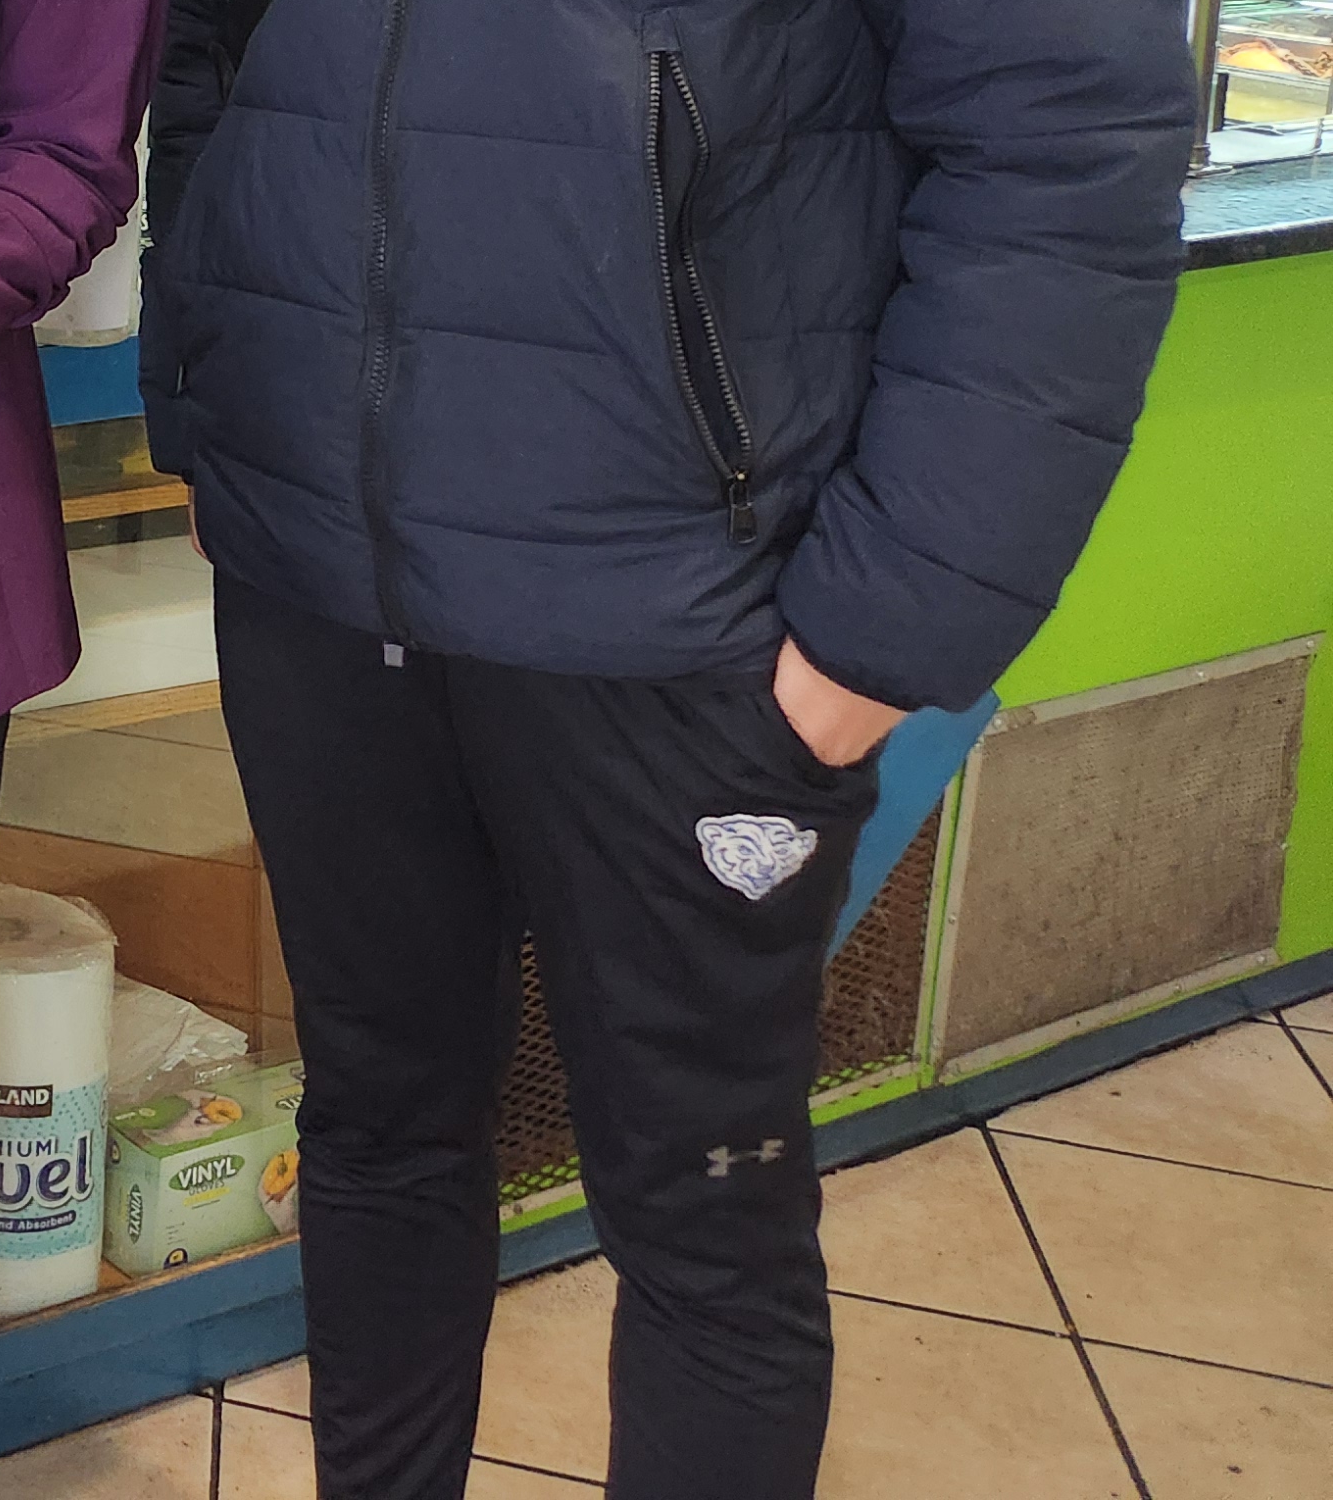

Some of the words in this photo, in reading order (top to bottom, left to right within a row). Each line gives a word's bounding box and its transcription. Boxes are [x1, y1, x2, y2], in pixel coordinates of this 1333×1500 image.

[178, 1157, 236, 1189] VINYL
[18, 1213, 74, 1231] Absorbent
[129, 1191, 143, 1236] VINYL
